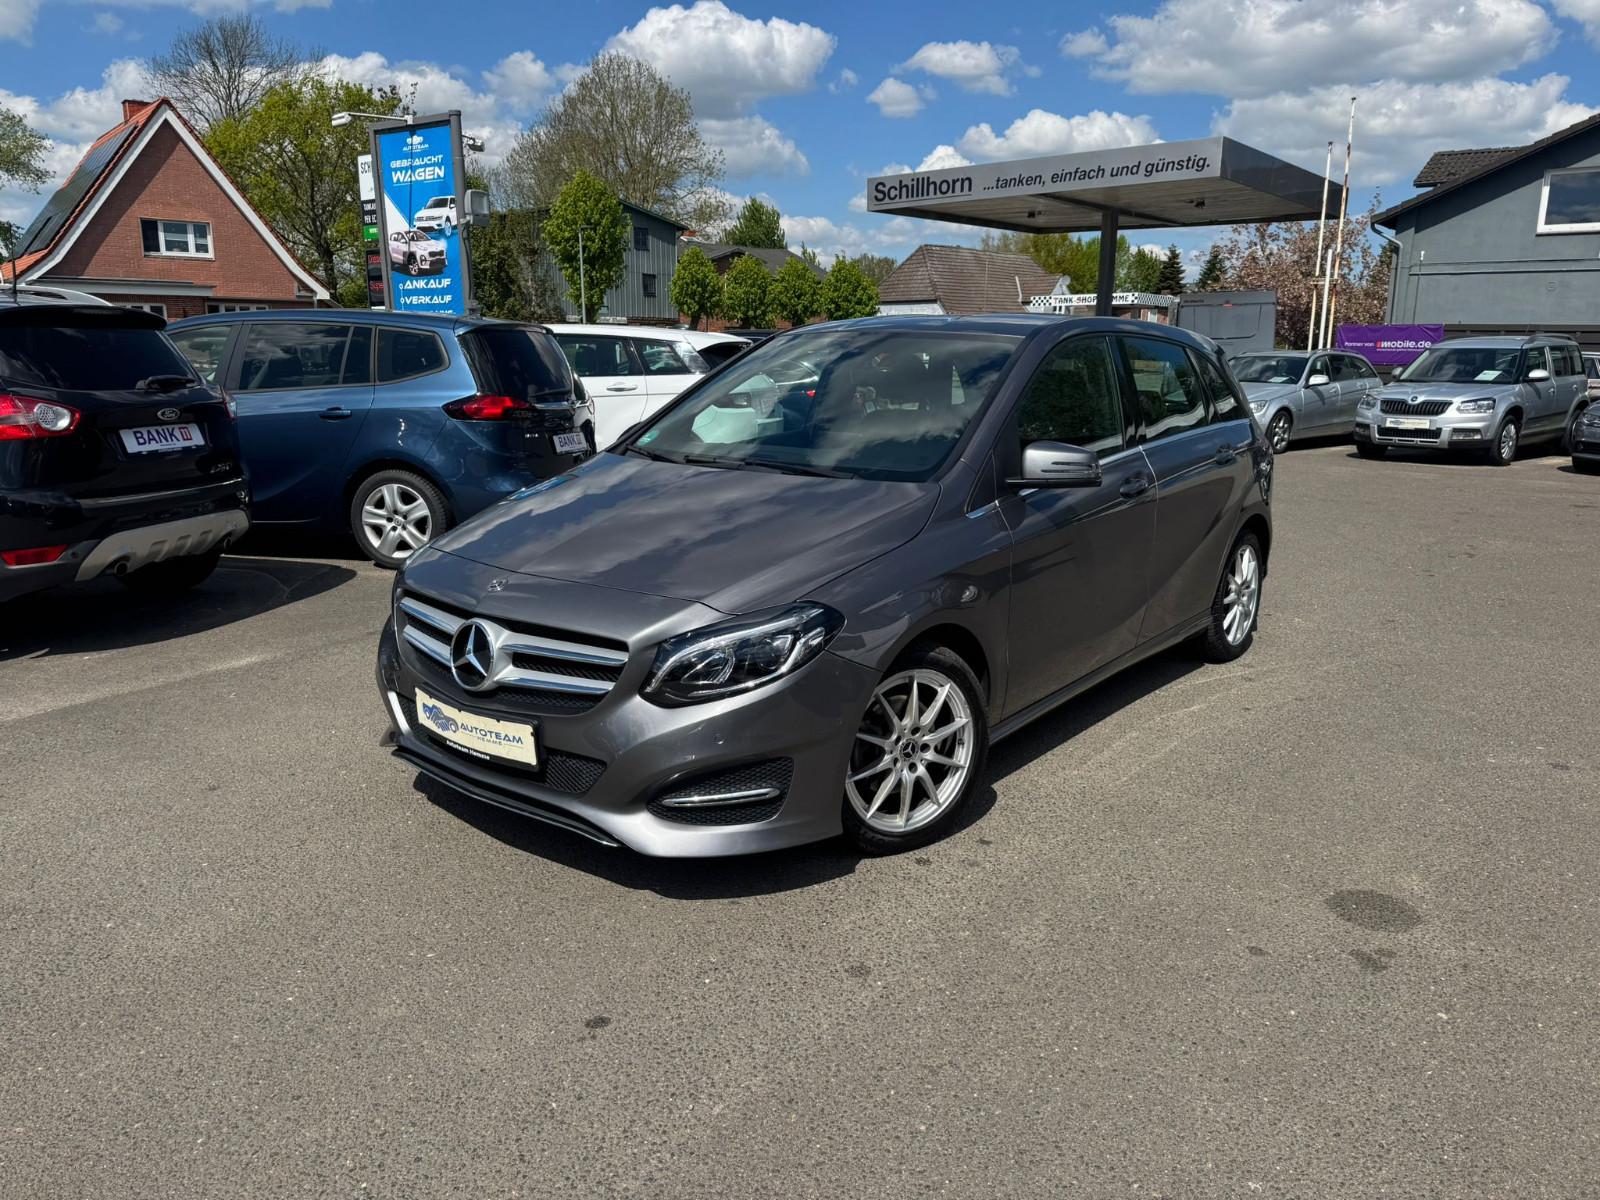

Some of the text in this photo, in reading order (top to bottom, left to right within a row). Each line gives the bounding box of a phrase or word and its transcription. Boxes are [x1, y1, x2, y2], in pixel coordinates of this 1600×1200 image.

[390, 155, 443, 168] GEBRAUCHT
[392, 166, 445, 183] WAGEN
[874, 176, 973, 202] Schillhorn
[1050, 165, 1105, 185] einfach
[1109, 160, 1141, 178] und
[1144, 154, 1211, 178] günstig.
[404, 278, 452, 290] ANKAUF
[404, 295, 453, 305] VERKAUF
[1380, 340, 1432, 348] mobile.de
[133, 427, 180, 446] BANK
[460, 722, 524, 745] AUTOTEAM
